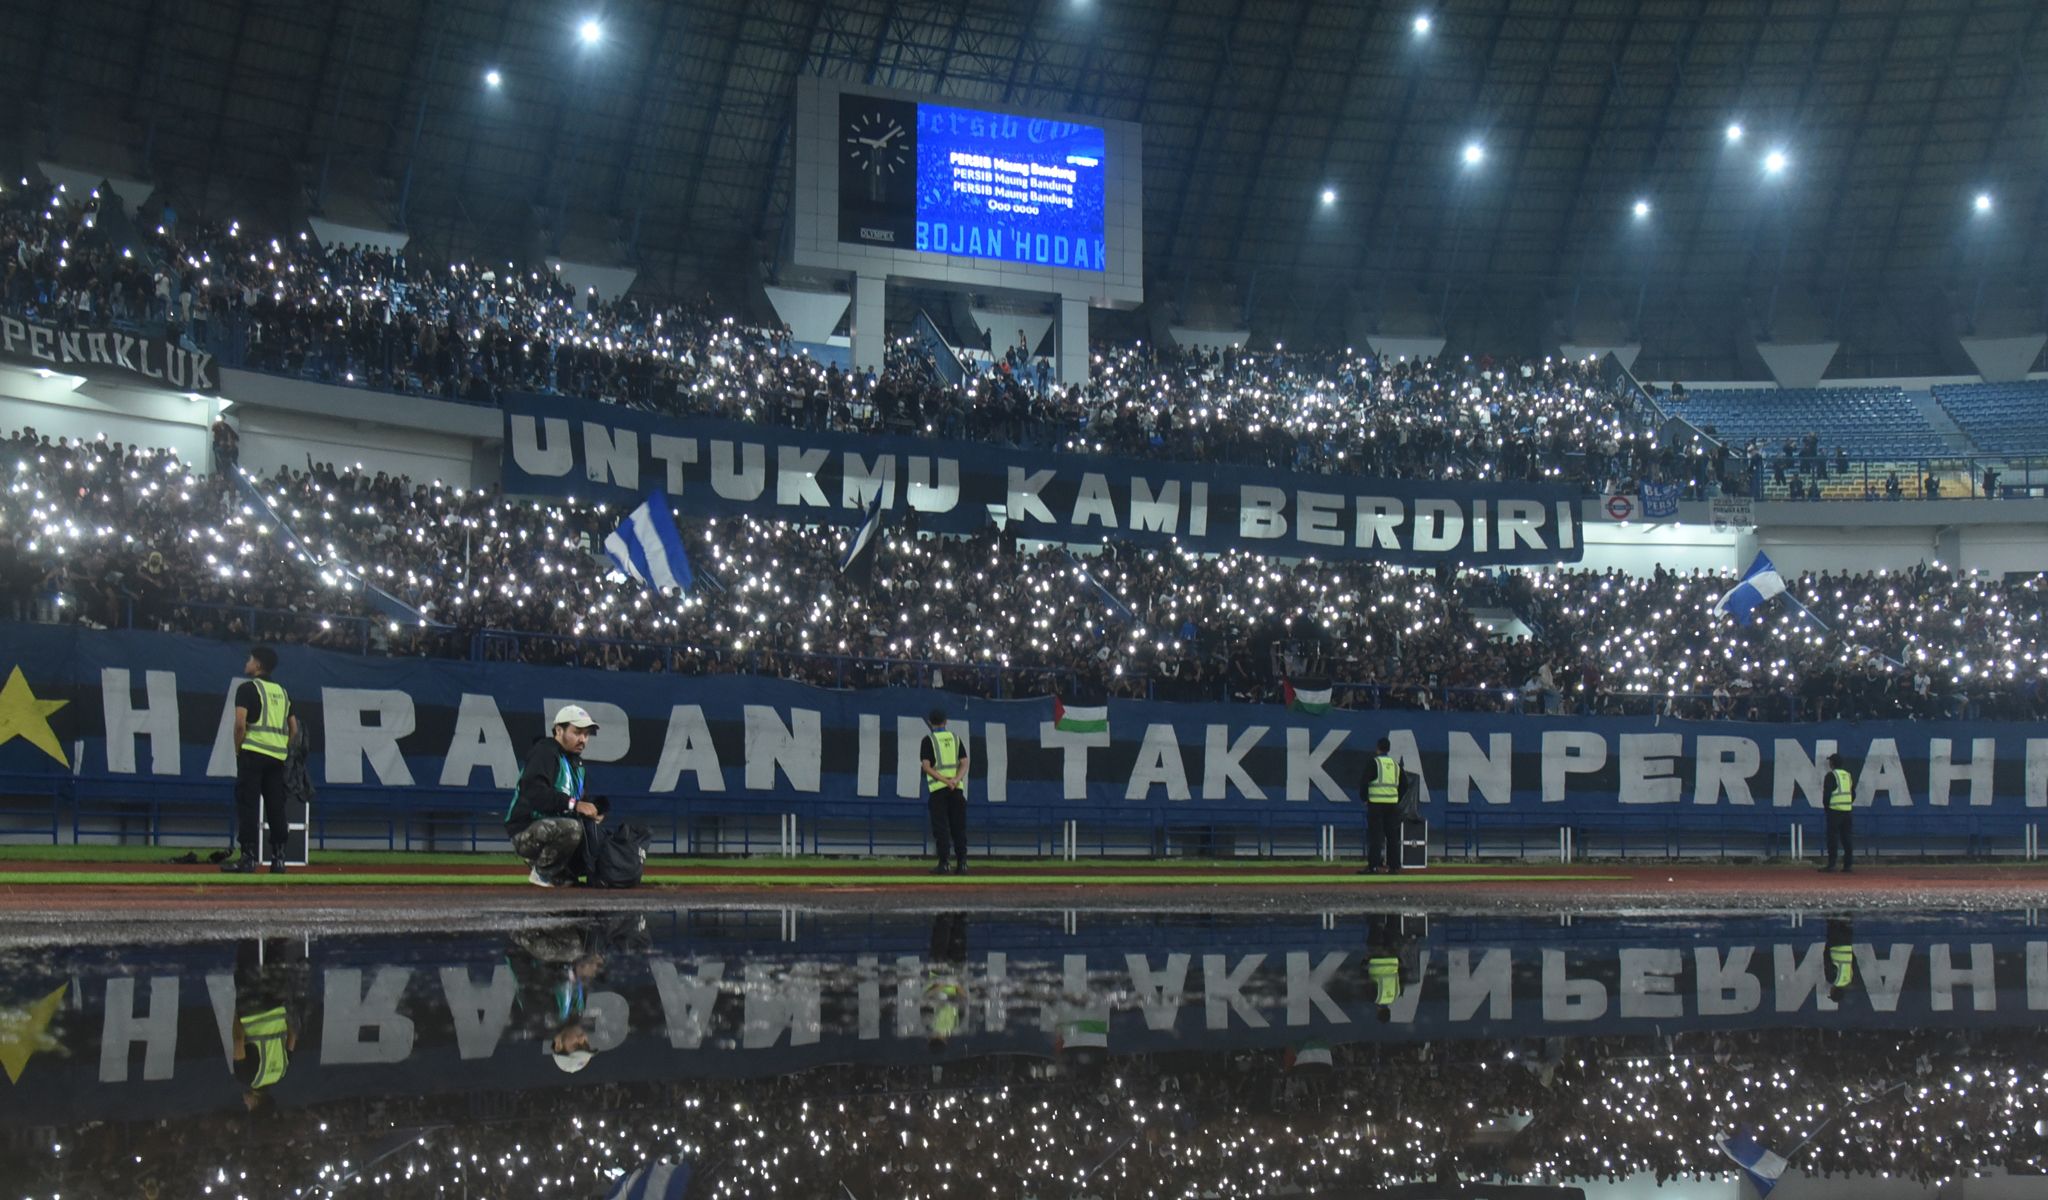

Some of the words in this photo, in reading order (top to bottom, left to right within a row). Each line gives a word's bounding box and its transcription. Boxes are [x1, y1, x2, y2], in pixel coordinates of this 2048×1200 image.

[950, 152, 992, 168] PERSIB
[953, 167, 993, 182] PERSIB
[995, 173, 1028, 189] Maung
[1030, 177, 1073, 195] Bandung
[953, 181, 993, 196] PERSIB
[995, 187, 1028, 203] Maung
[1030, 191, 1073, 208] Bandung
[916, 221, 1001, 257] BOJAN
[1, 315, 213, 389] PENAKLUK
[510, 413, 960, 514] UNTUKMU
[1006, 466, 1208, 537] KAMI
[1240, 485, 1575, 552] BERDIRI
[1542, 730, 1996, 807] PERNAH
